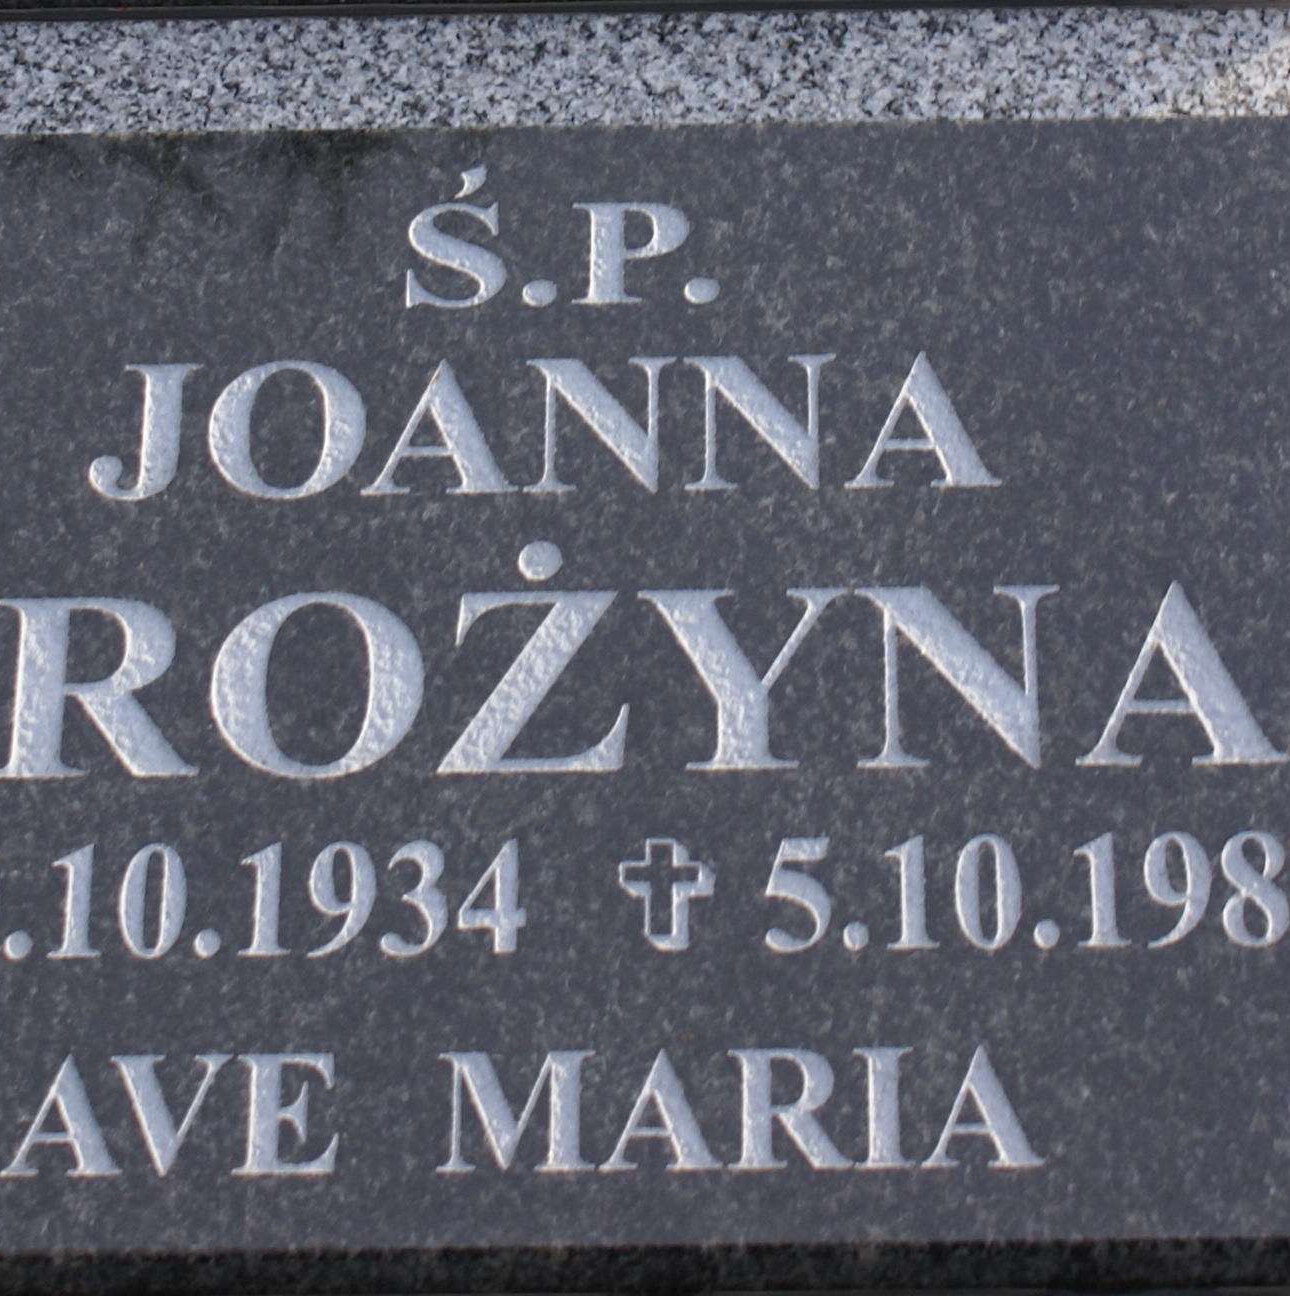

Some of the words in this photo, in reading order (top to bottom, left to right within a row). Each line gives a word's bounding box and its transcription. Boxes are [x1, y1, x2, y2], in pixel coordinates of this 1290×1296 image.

[404, 164, 719, 309] Ś.P.
[86, 352, 1003, 503] JOANNA
[435, 1045, 1045, 1175] MARIA
